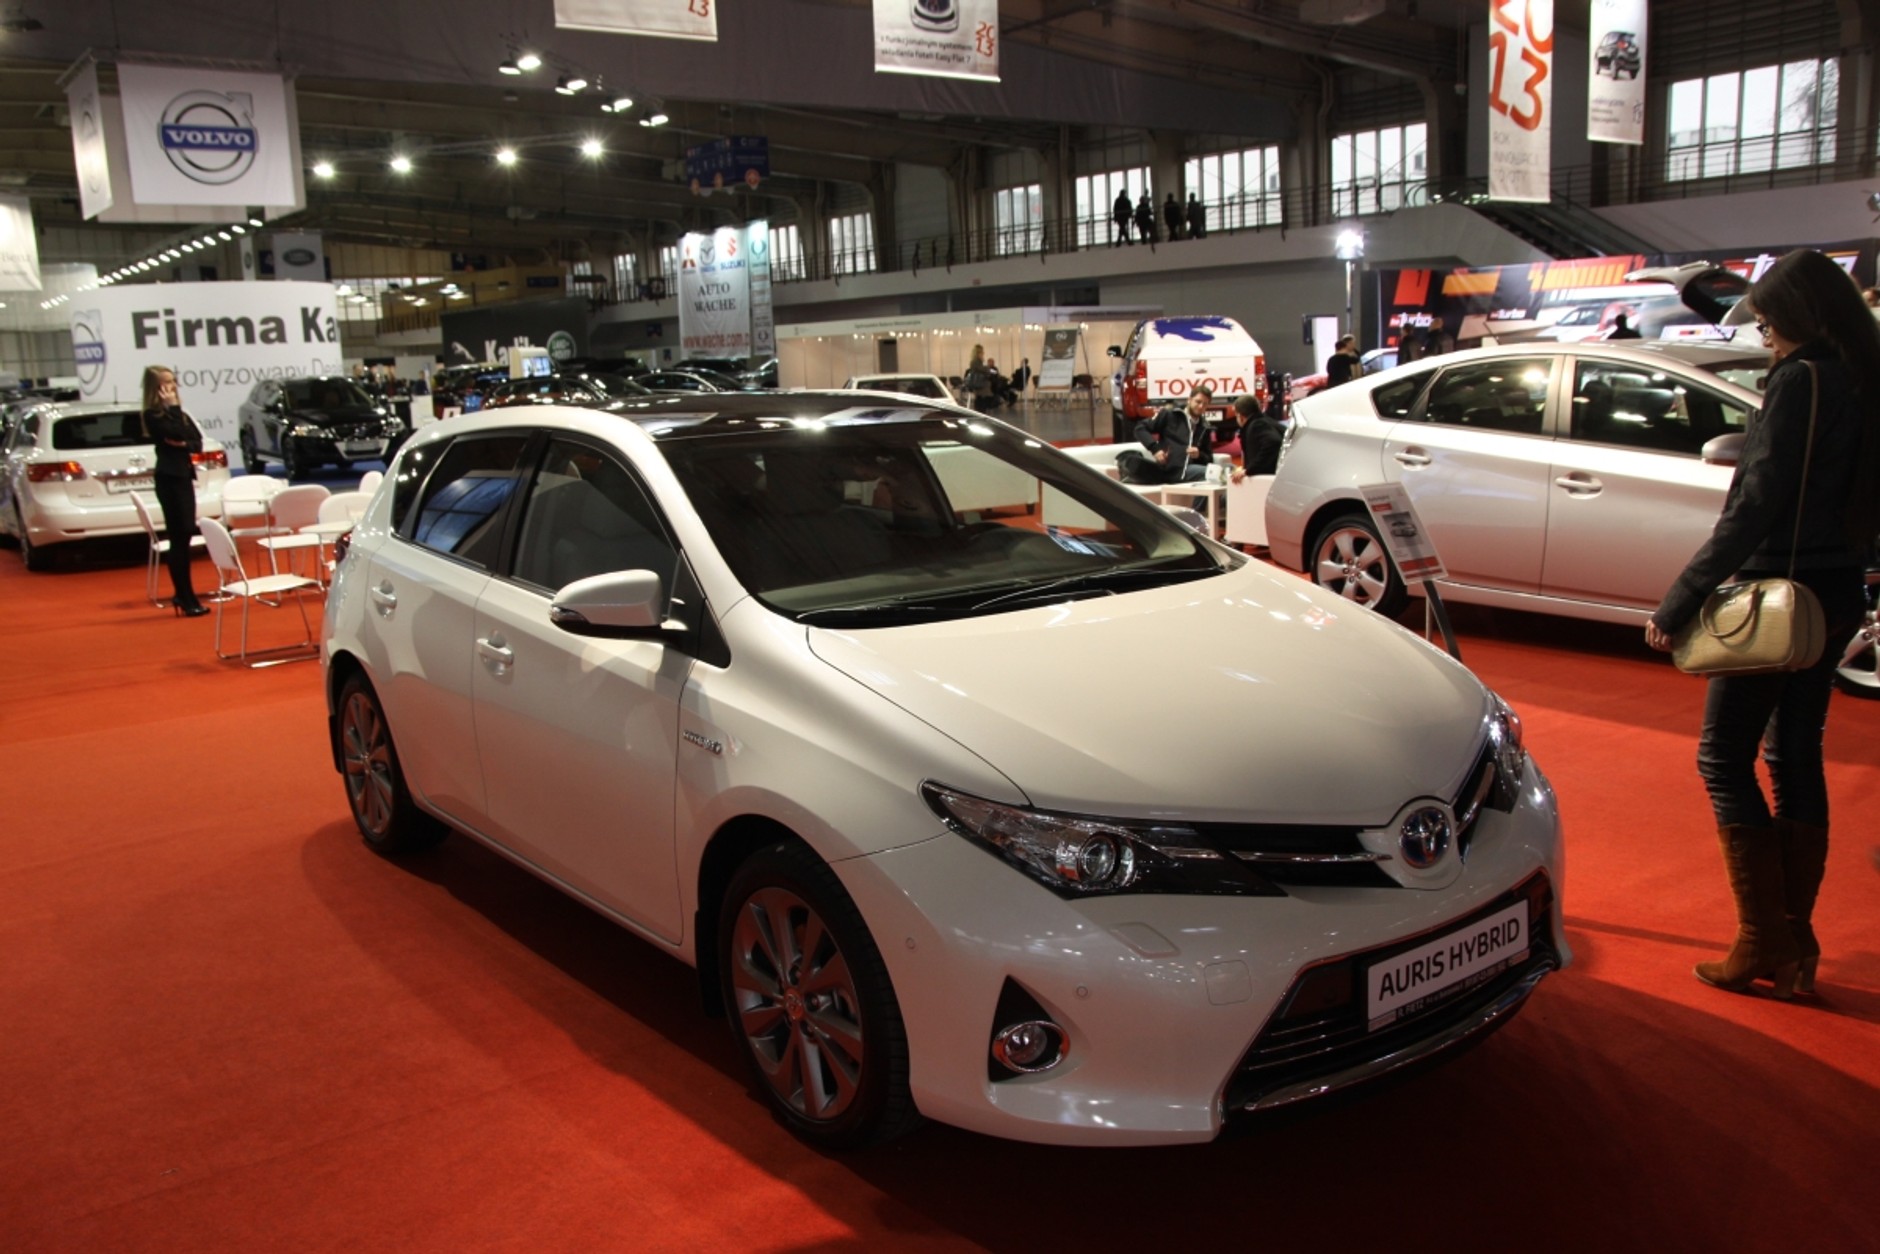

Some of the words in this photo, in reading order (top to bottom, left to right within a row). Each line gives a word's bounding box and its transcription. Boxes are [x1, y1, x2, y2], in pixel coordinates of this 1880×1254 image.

[166, 129, 250, 146] VOLVO
[698, 282, 730, 296] AUTO
[694, 298, 737, 312] WACHE
[131, 308, 288, 349] Firma
[1155, 377, 1248, 396] TOYOTA
[1378, 951, 1445, 1002] AURIS
[1449, 917, 1520, 972] HYBRID
